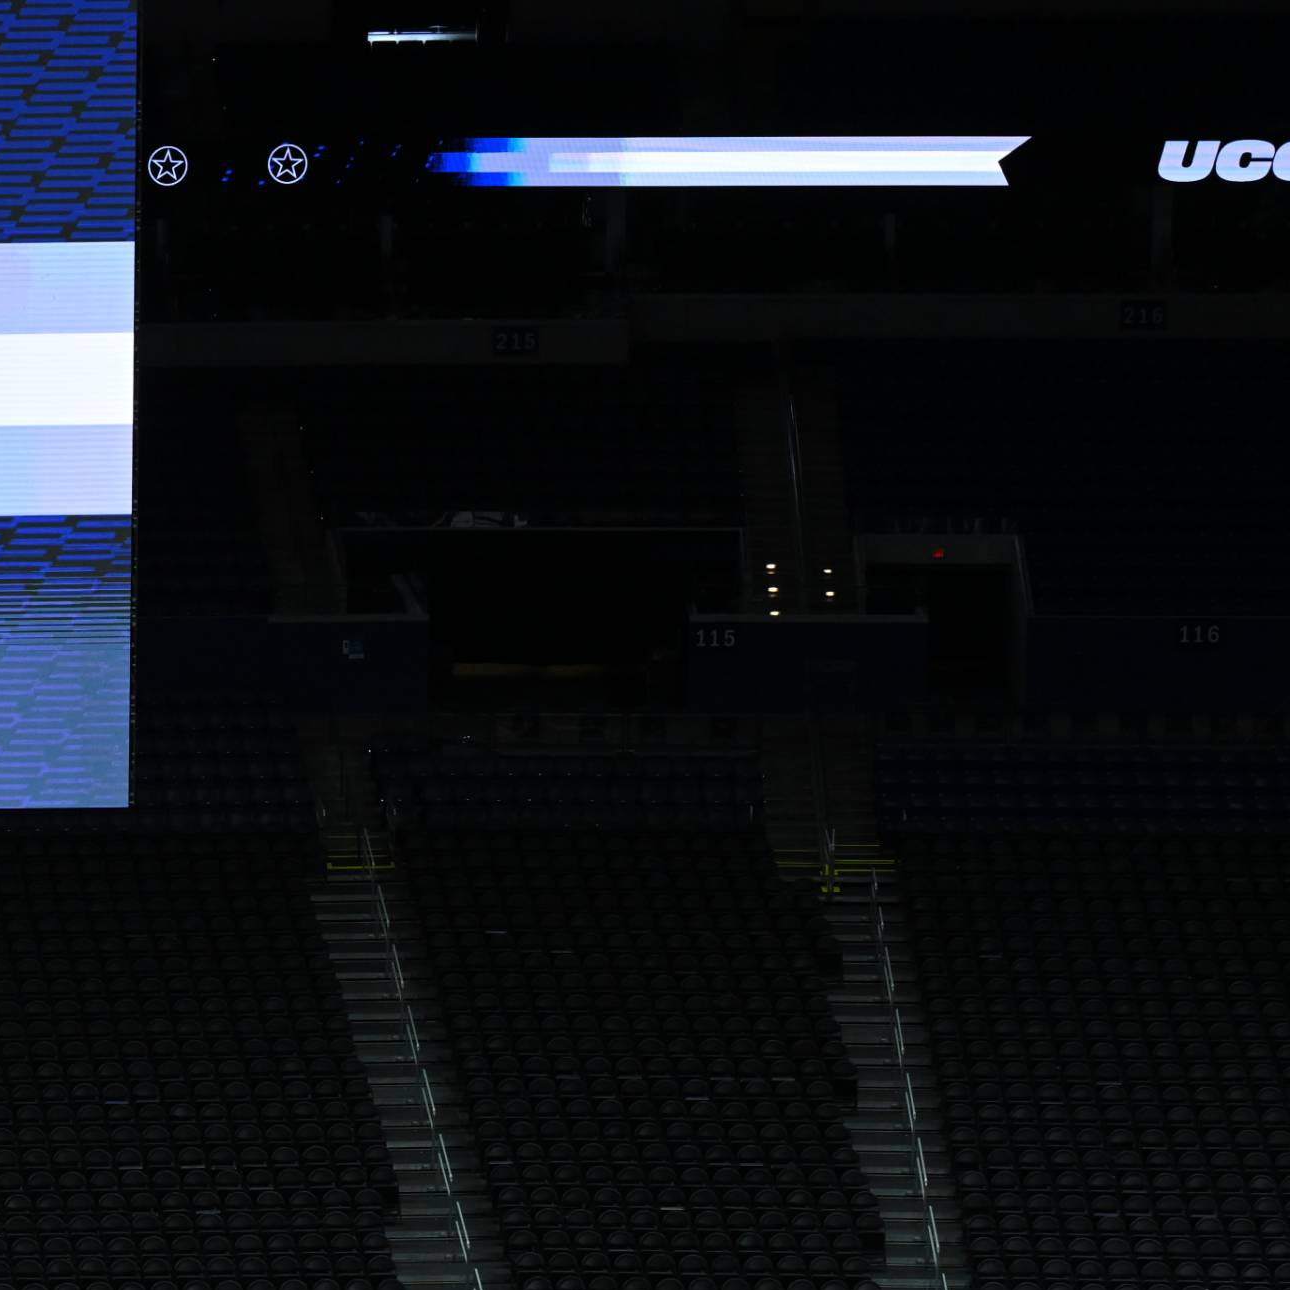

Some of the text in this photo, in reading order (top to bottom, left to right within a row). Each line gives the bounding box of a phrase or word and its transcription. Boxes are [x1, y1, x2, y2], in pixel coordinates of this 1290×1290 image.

[1122, 306, 1164, 325] 216
[495, 333, 537, 351] 215
[695, 628, 737, 649] 115
[1179, 625, 1220, 645] 116
